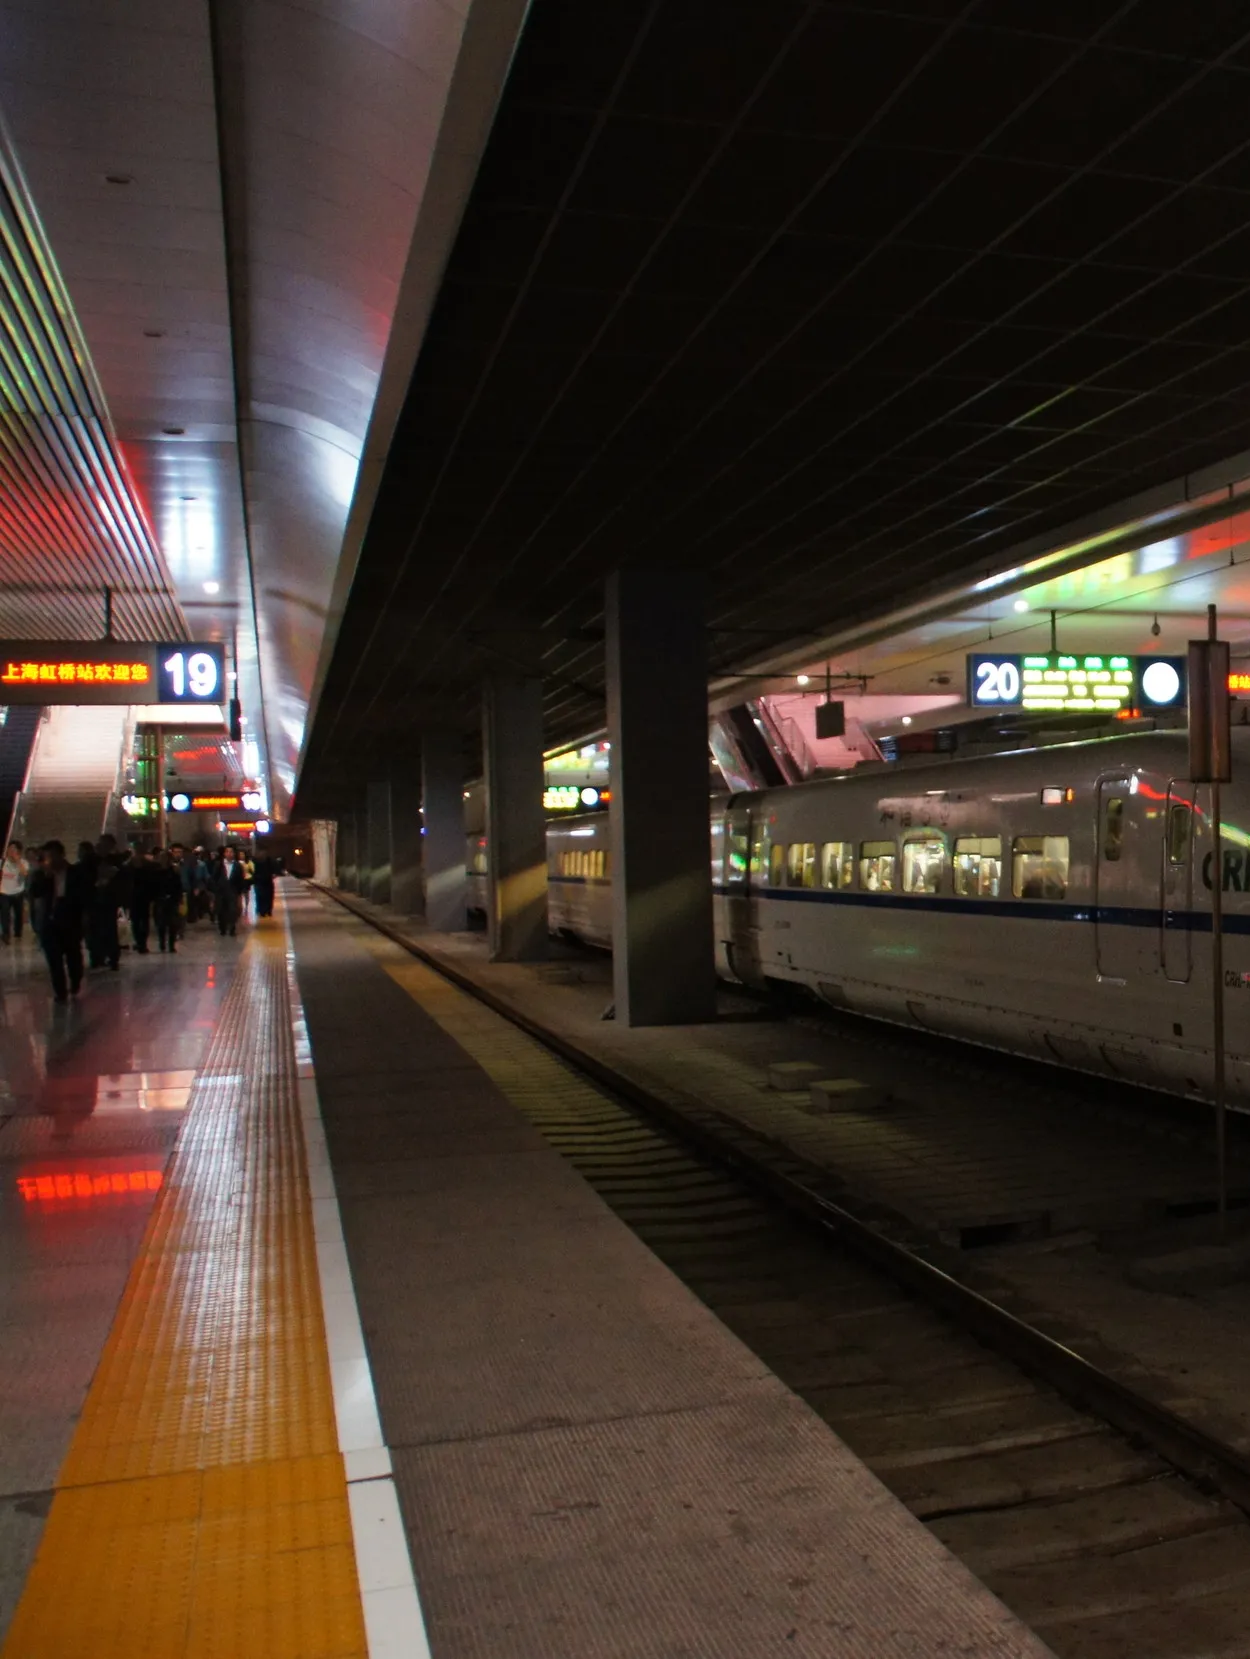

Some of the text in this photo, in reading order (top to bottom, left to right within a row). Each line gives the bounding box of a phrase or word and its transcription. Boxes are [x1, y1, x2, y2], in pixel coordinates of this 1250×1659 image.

[2, 663, 149, 682] 上海虹桥站欢迎您
[164, 652, 218, 697] 19
[976, 661, 1020, 701] 20
